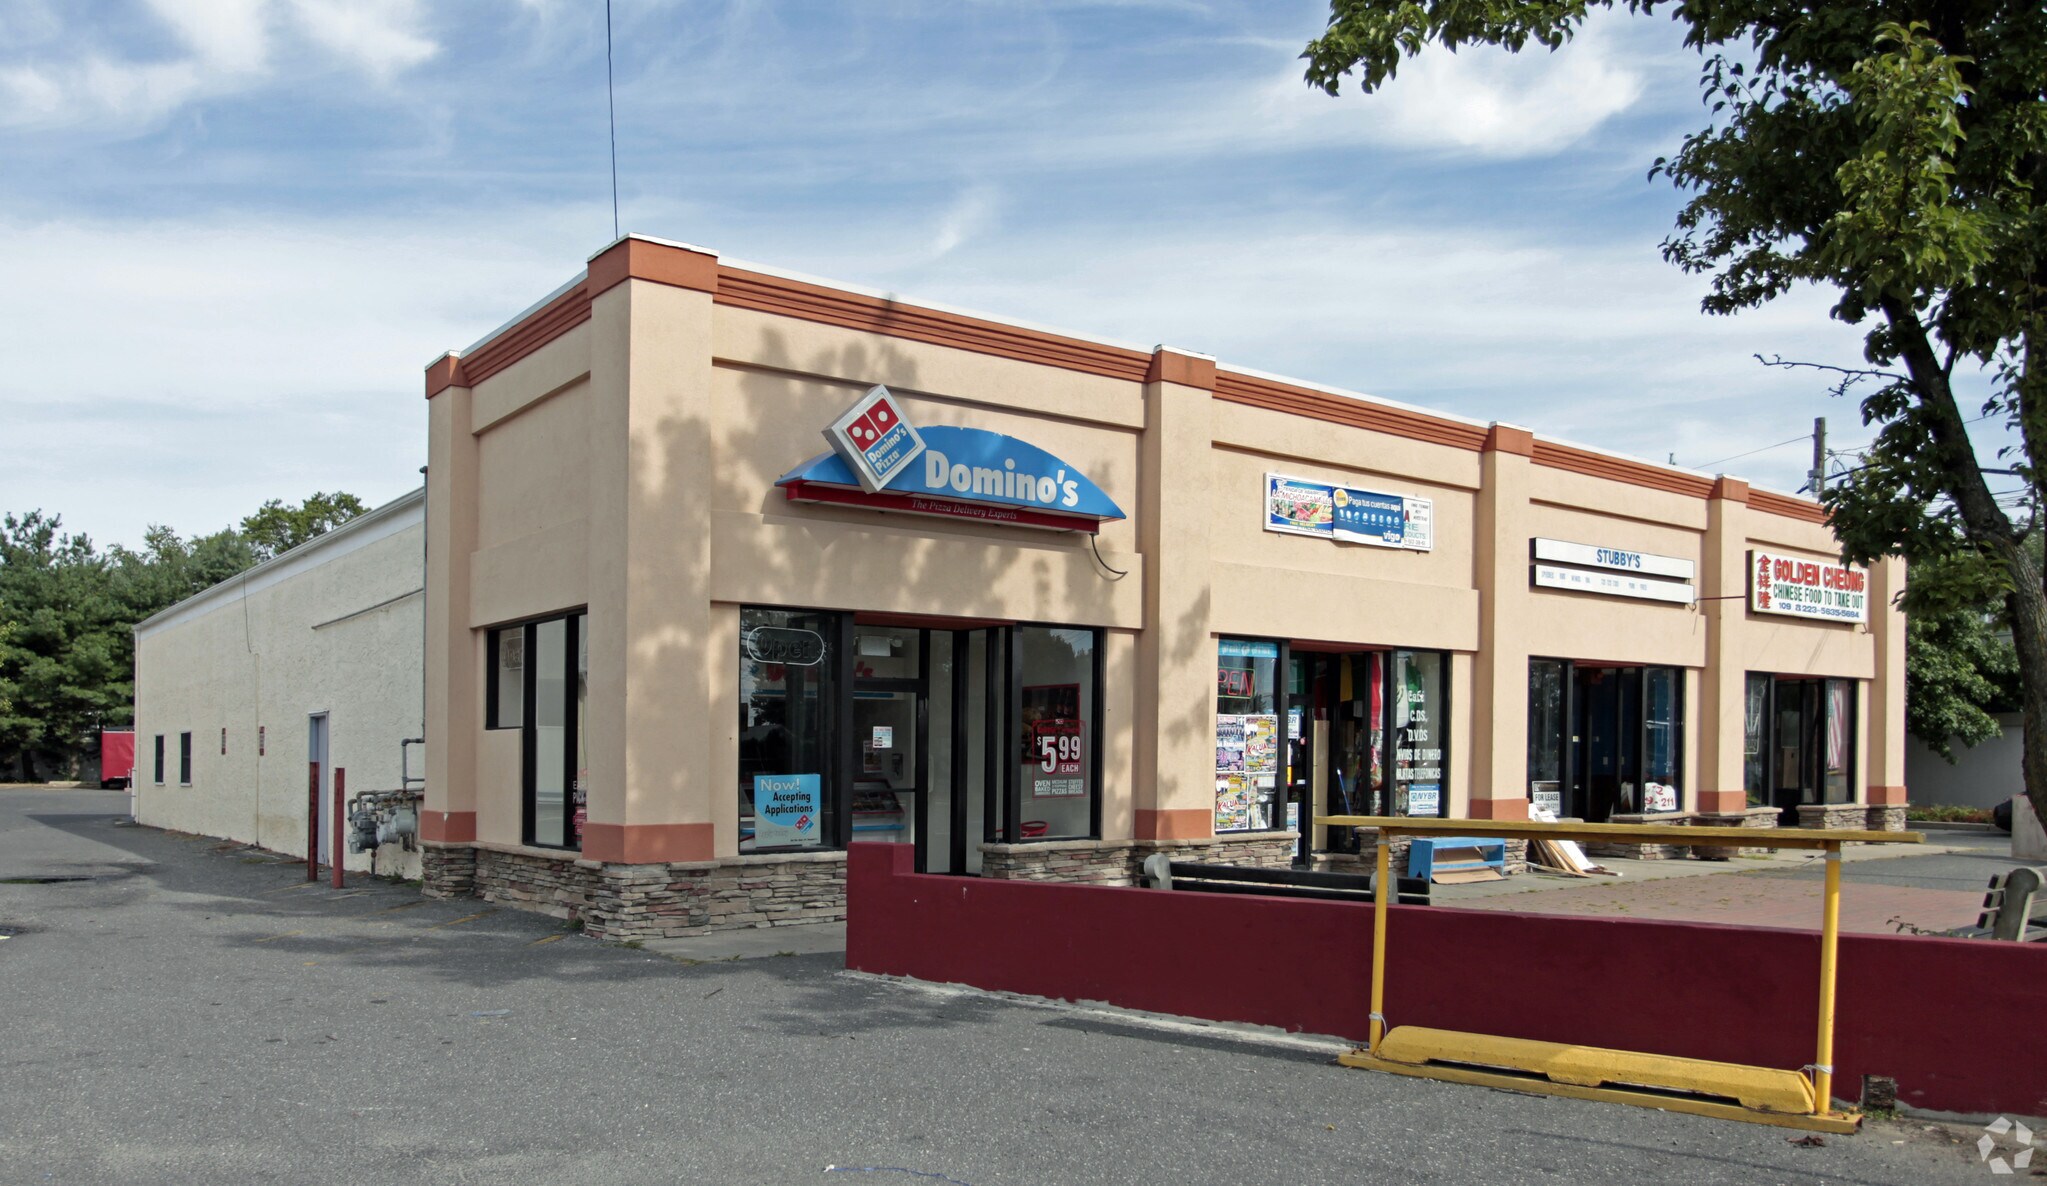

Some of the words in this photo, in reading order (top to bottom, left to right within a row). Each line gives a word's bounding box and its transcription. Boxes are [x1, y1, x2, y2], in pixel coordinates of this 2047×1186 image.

[867, 427, 907, 463] Domino's
[874, 449, 900, 473] Pizza
[925, 450, 1079, 508] Domino's
[912, 499, 926, 509] The
[929, 500, 951, 512] Pizza
[953, 504, 986, 517] Delivery
[988, 508, 1017, 519] Experts
[1348, 496, 1362, 507] Paga
[1362, 499, 1370, 508] tus
[1370, 501, 1390, 510] cuentas
[1383, 530, 1400, 543] vigo
[1404, 531, 1426, 540] ODUCTS
[1596, 548, 1640, 569] STUBBY'S
[1774, 558, 1820, 587] GOLDEN
[1823, 566, 1864, 593] CHEUNG
[1773, 583, 1802, 602] CHINESE
[1804, 588, 1822, 604] FOOD
[1824, 590, 1832, 606] TO
[1834, 592, 1850, 608] TAKE
[1852, 595, 1863, 610] OUT
[1218, 669, 1254, 696] PEN
[1396, 748, 1413, 761] NVIOS
[1414, 748, 1421, 760] DE
[1422, 748, 1441, 760] DINERO
[1061, 764, 1079, 773] EACH
[760, 778, 800, 791] Now!
[773, 791, 811, 803] Accepting
[1417, 791, 1437, 800] NYBR
[1535, 793, 1545, 801] FOR
[1545, 793, 1559, 801] LEASE
[765, 803, 813, 816] Applications
